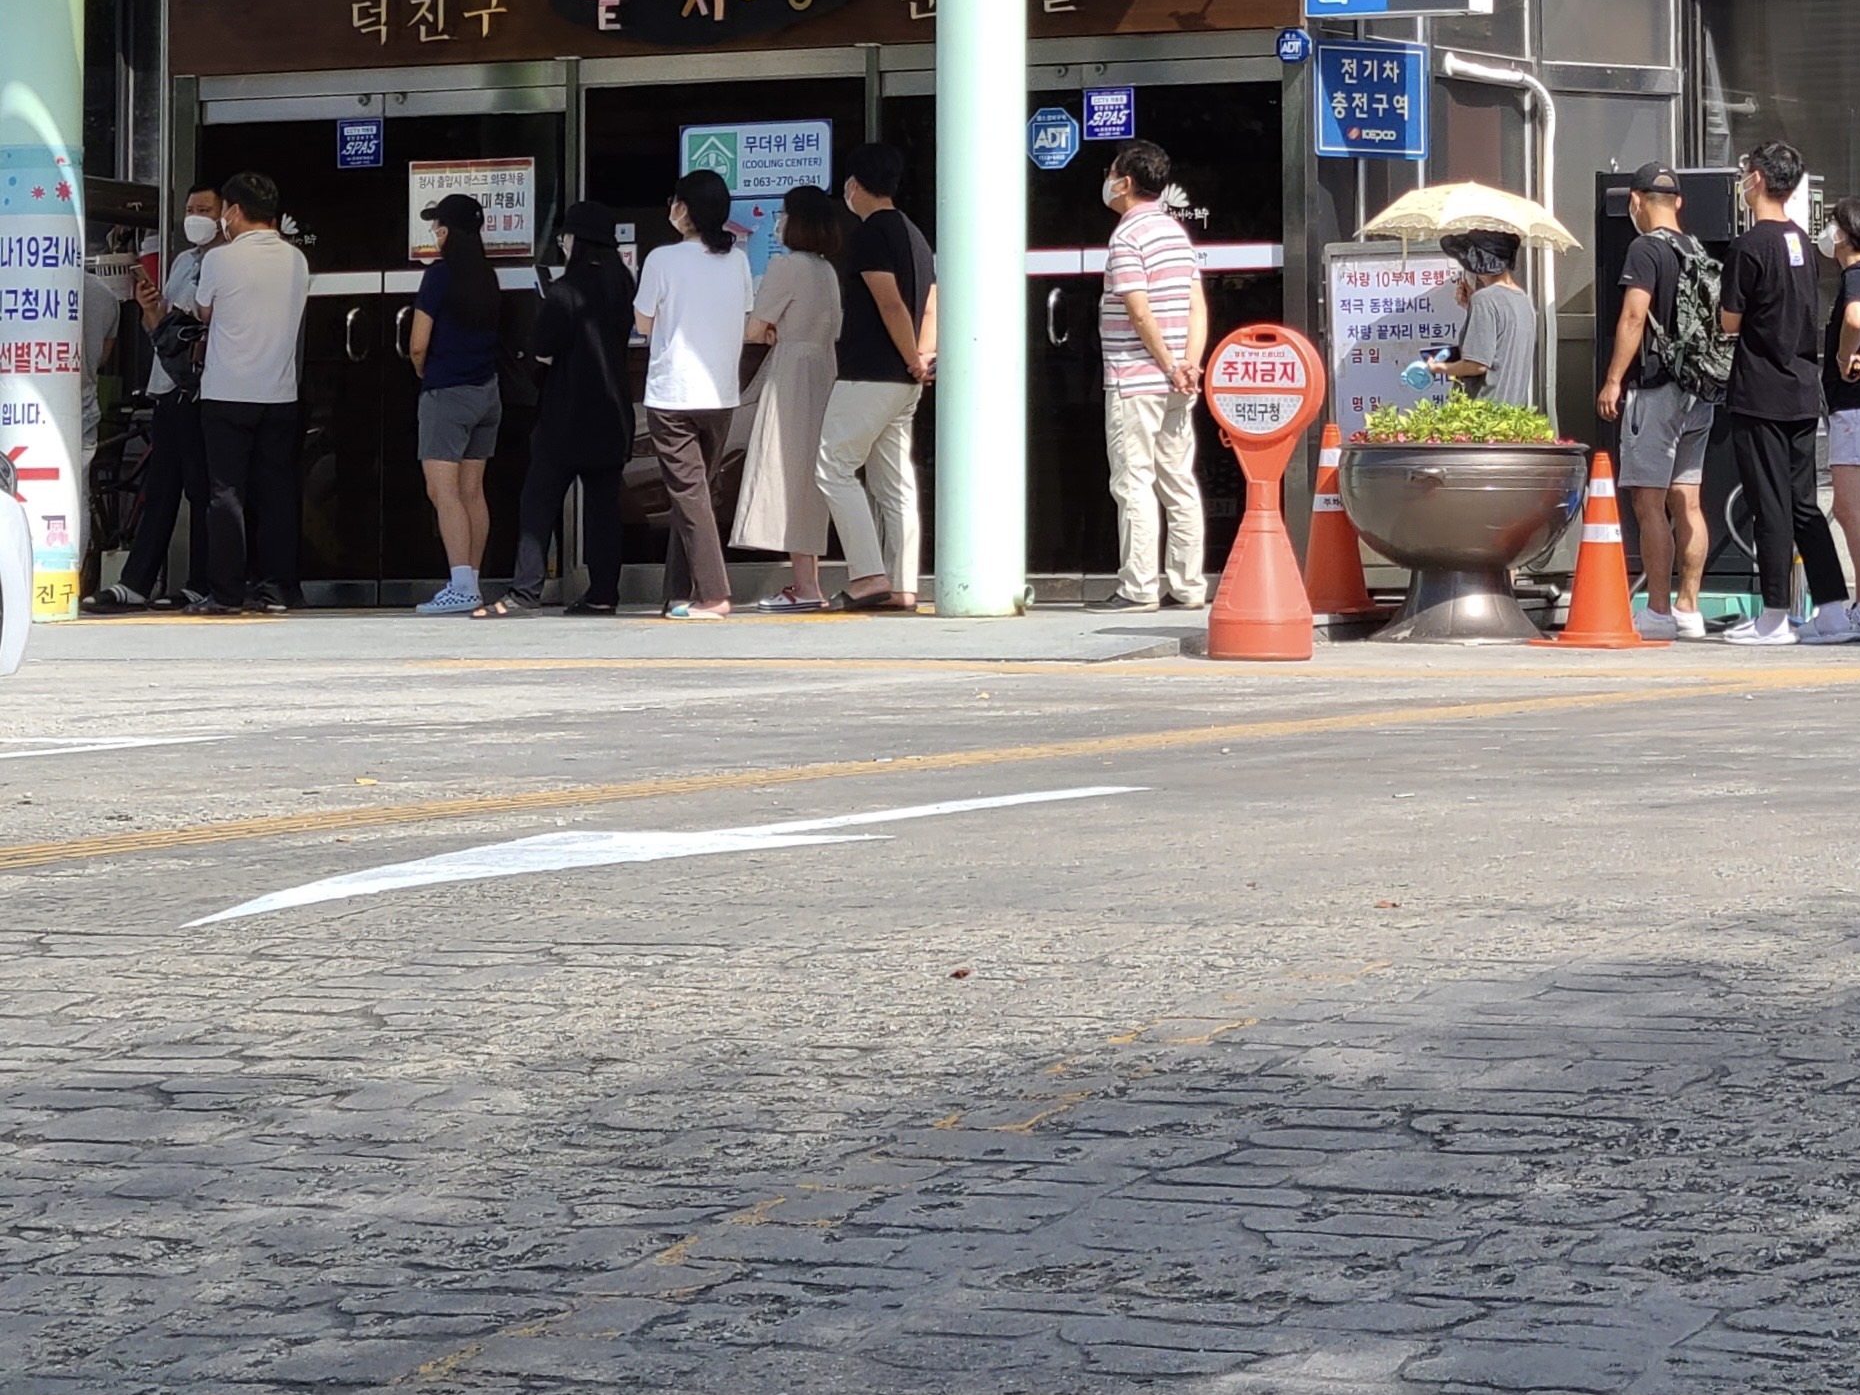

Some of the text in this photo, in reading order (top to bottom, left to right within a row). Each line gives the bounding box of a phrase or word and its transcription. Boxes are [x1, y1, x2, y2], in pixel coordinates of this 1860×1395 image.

[1281, 41, 1302, 54] ADT
[1341, 58, 1400, 84] 전기차
[1331, 90, 1409, 121] 충전구역
[1087, 110, 1131, 126] SPAS
[743, 133, 820, 153] 무더위 쉼터
[1033, 126, 1070, 149] ADT
[341, 139, 379, 156] SPAS
[742, 157, 822, 169] (COOLING CENTER)
[753, 174, 821, 187] 063-270-6341
[494, 191, 525, 210] 착용시
[503, 213, 524, 231] 불가
[0, 288, 60, 321] 구청사
[1340, 297, 1435, 314] 적극 동참합시다.
[1347, 322, 1457, 341] 차량 끝자리 번호가
[1221, 361, 1296, 383] 주차금지
[1234, 402, 1281, 422] 덕진구청
